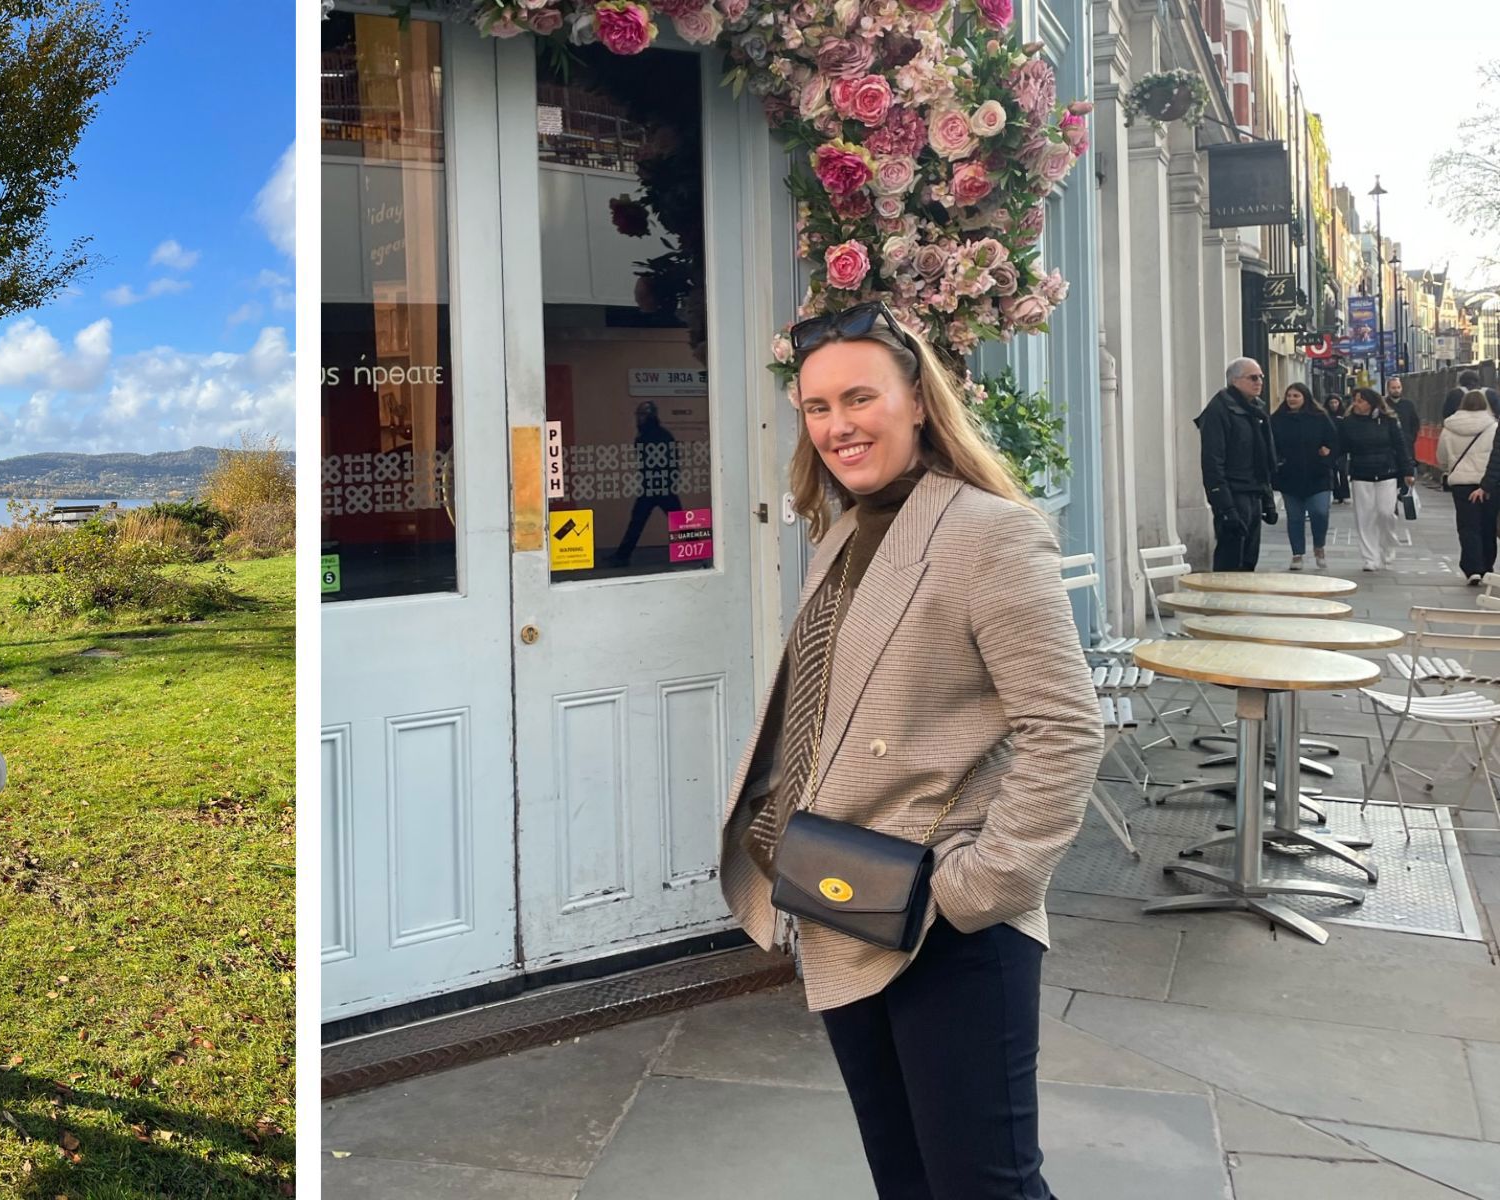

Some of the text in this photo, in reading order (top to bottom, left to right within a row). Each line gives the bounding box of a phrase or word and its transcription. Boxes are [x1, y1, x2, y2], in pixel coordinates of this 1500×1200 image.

[549, 429, 561, 490] PUSH
[677, 543, 705, 557] 2017
[325, 572, 334, 583] 5
